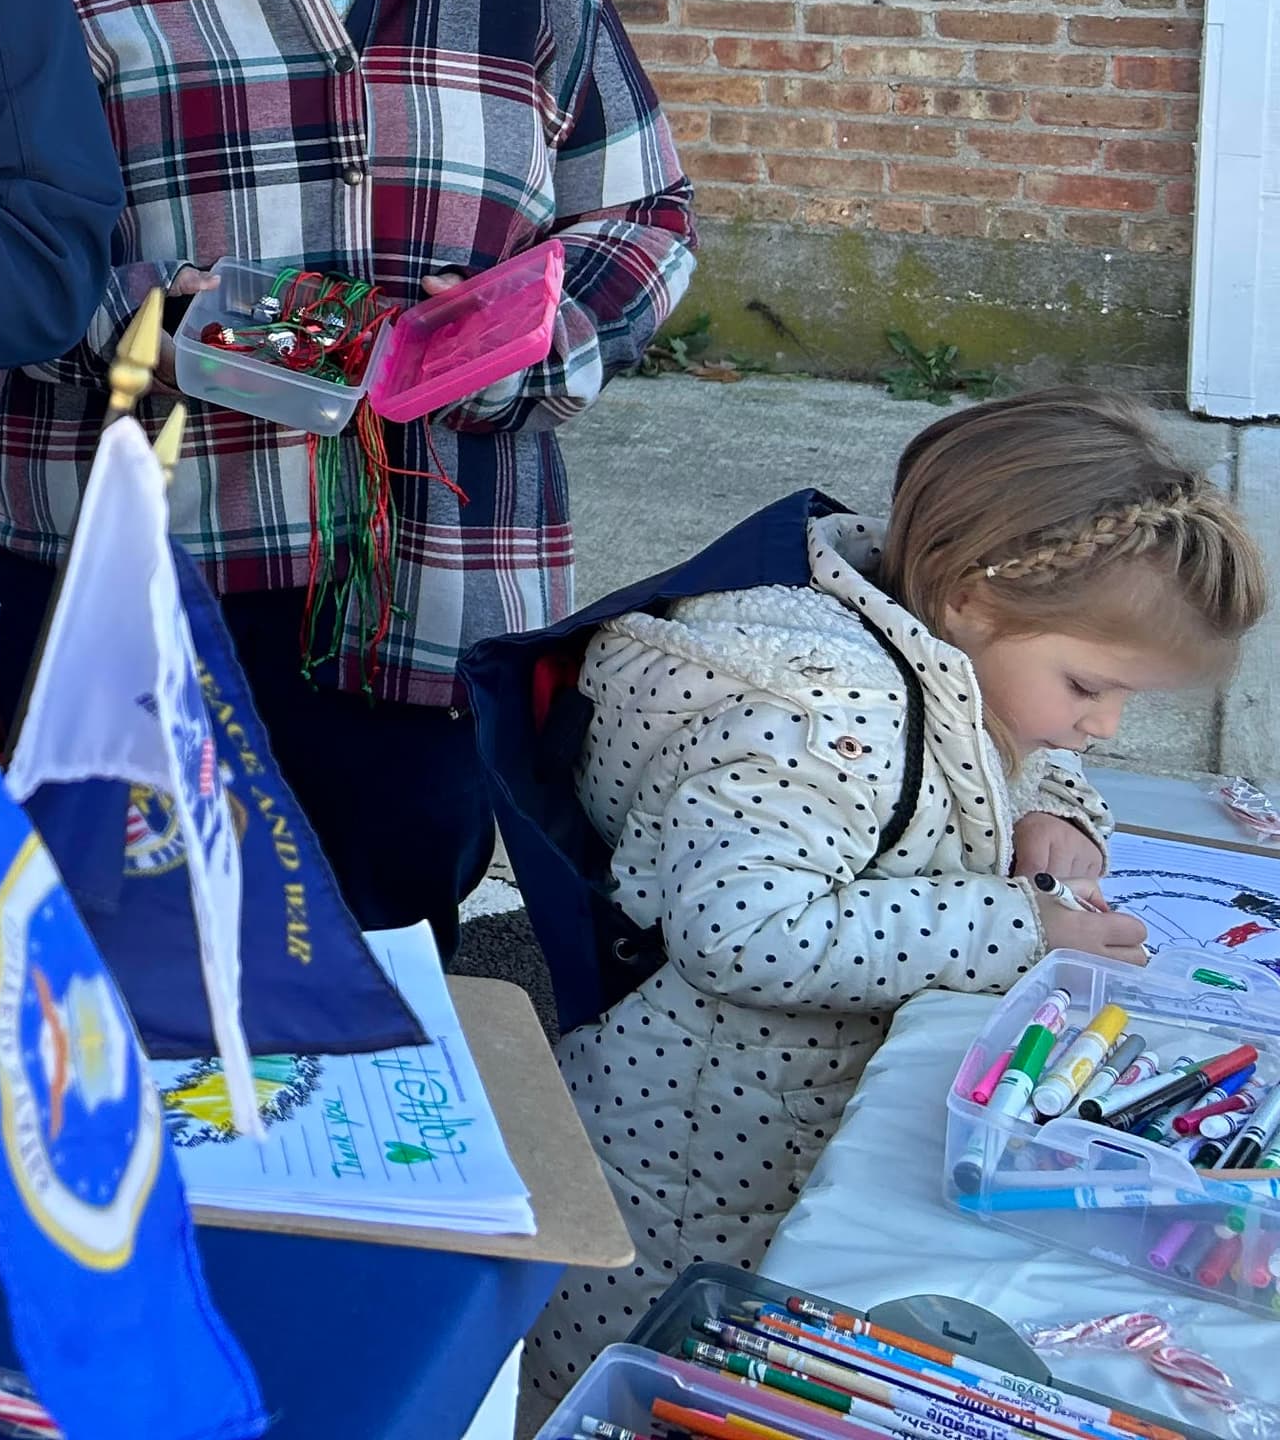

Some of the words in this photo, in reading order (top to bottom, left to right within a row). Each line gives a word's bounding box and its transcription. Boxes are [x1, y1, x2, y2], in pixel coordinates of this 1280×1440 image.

[251, 784, 300, 871] AND
[284, 882, 313, 966] WAR
[1001, 1374, 1063, 1409] Crayola
